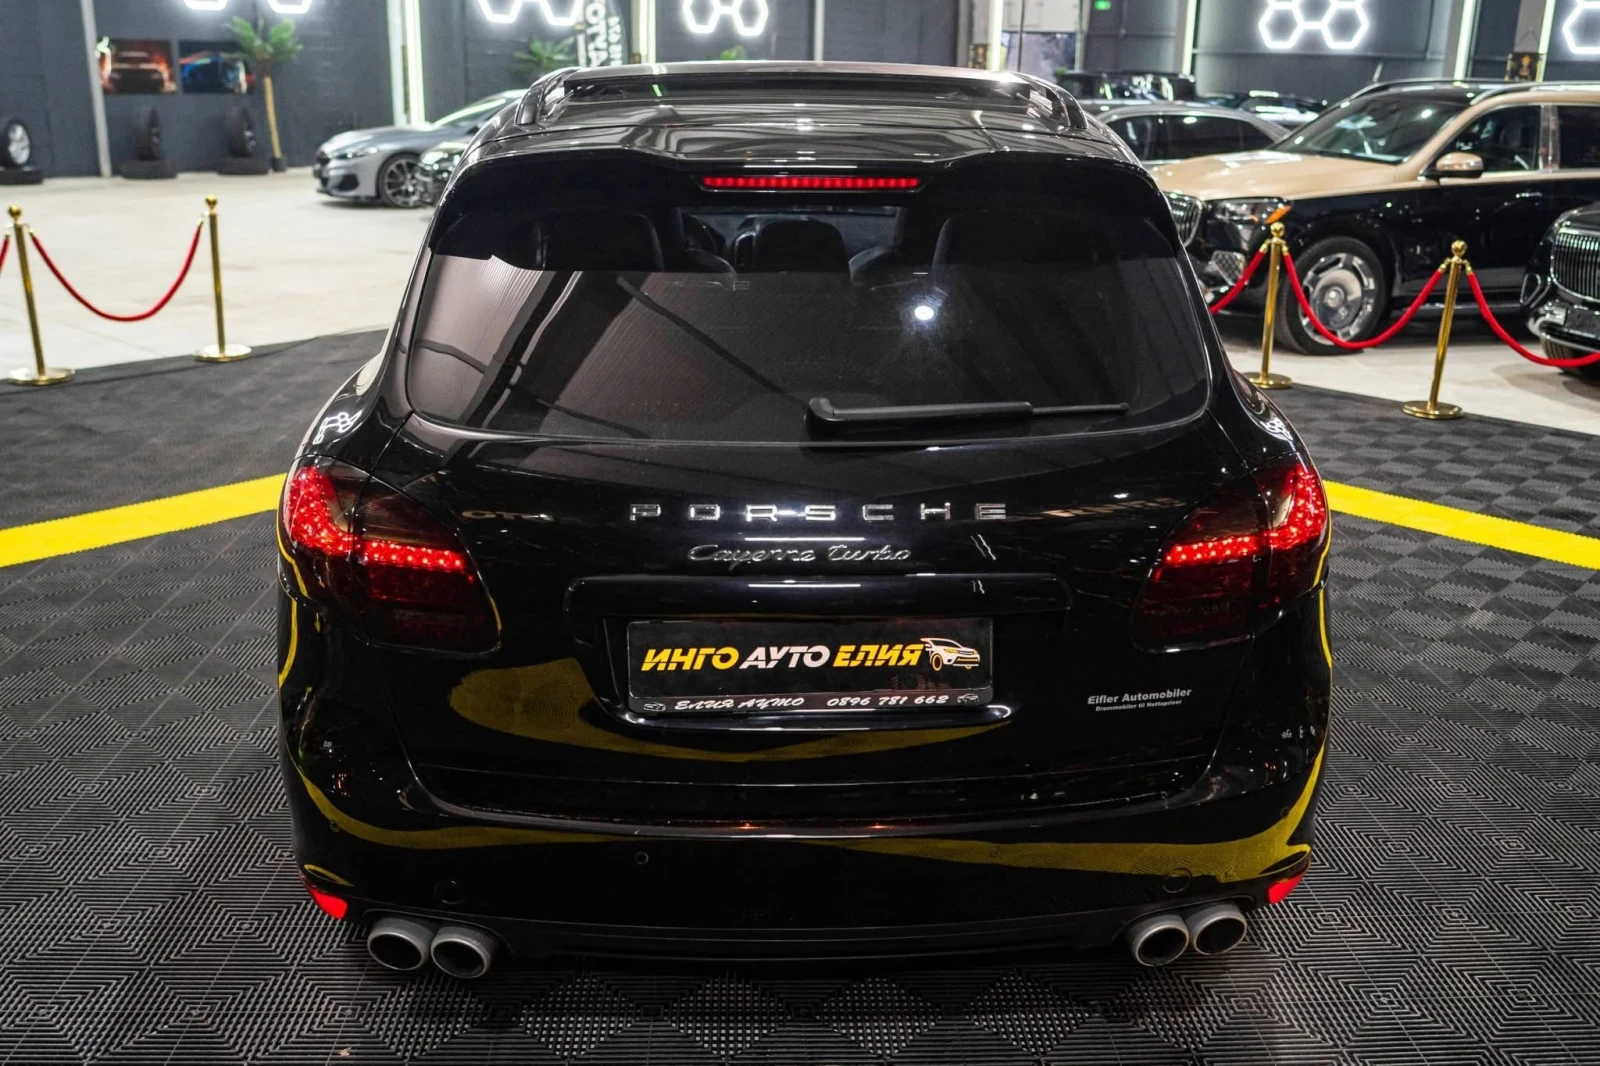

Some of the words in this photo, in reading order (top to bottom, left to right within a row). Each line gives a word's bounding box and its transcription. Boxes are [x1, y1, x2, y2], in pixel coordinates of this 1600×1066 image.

[629, 502, 1006, 522] PORSCHE
[687, 544, 816, 571] Cayenne
[641, 647, 739, 672] ИНГО
[739, 645, 831, 669] АУТО
[833, 643, 925, 668] ЕЛИЯ
[827, 697, 871, 707] 0896
[878, 697, 908, 706] 781
[914, 695, 949, 705] 662
[1087, 695, 1119, 705] Eifler
[1121, 688, 1192, 702] Automobiler
